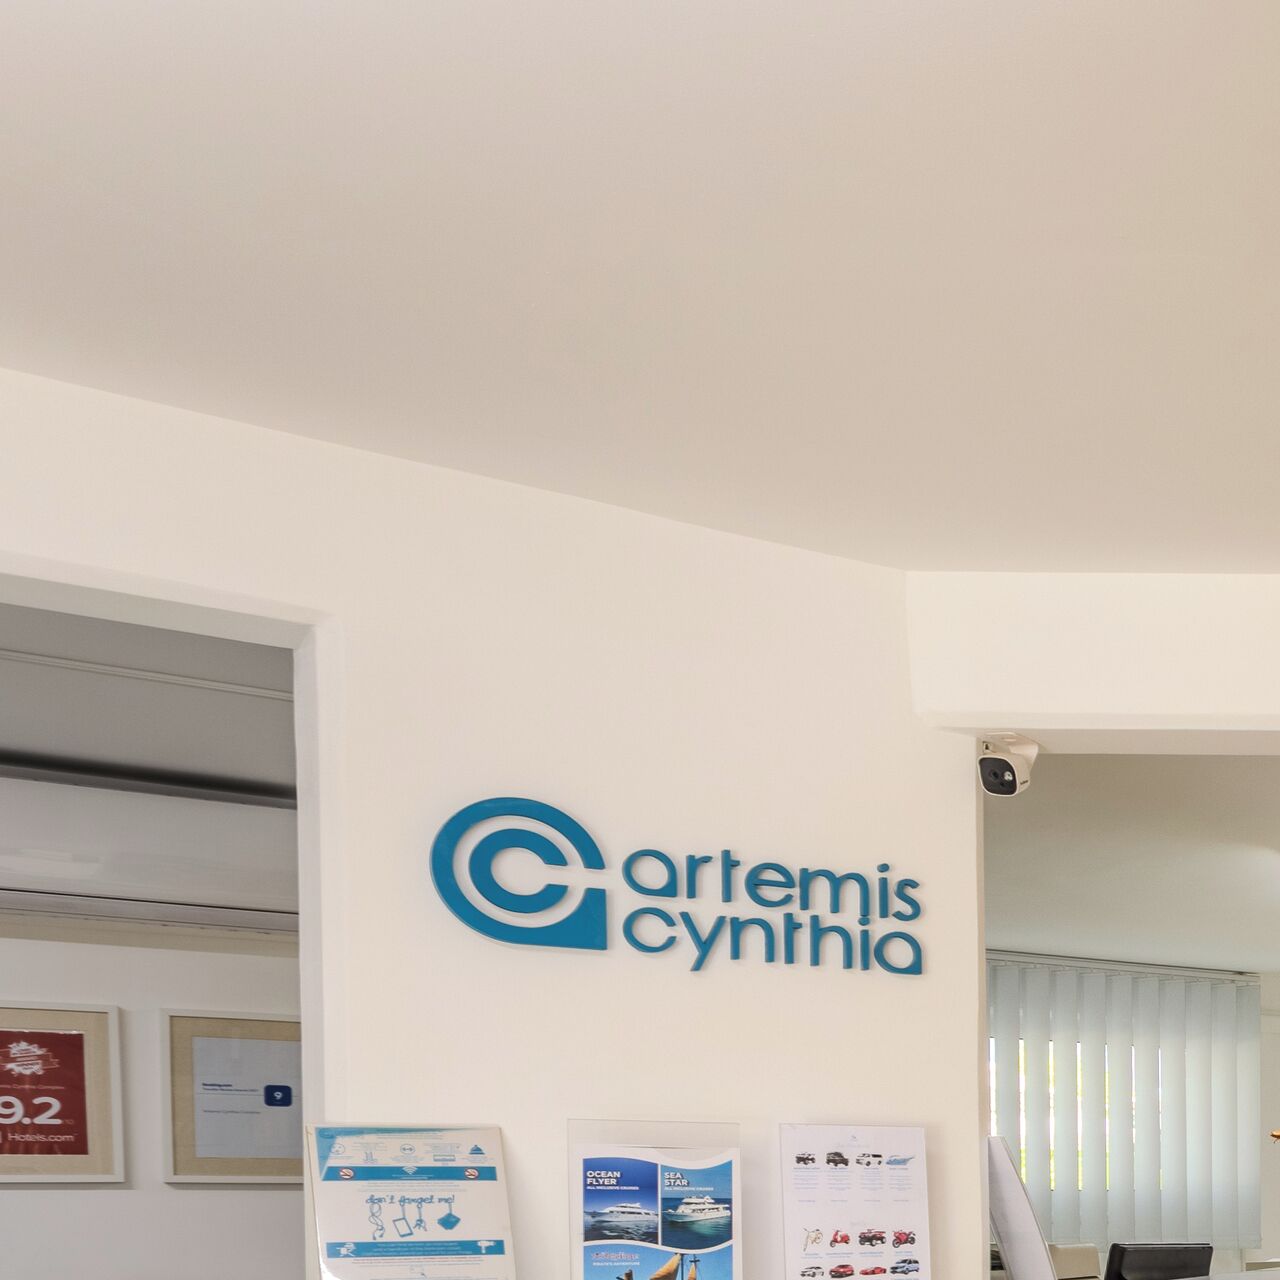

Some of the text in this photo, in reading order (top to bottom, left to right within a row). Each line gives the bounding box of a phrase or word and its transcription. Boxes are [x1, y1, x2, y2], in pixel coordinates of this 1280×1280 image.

[621, 848, 922, 922] artemis
[622, 907, 923, 976] cynthia
[7, 1132, 76, 1142] Hotels.com
[586, 1170, 621, 1178] OCEAN
